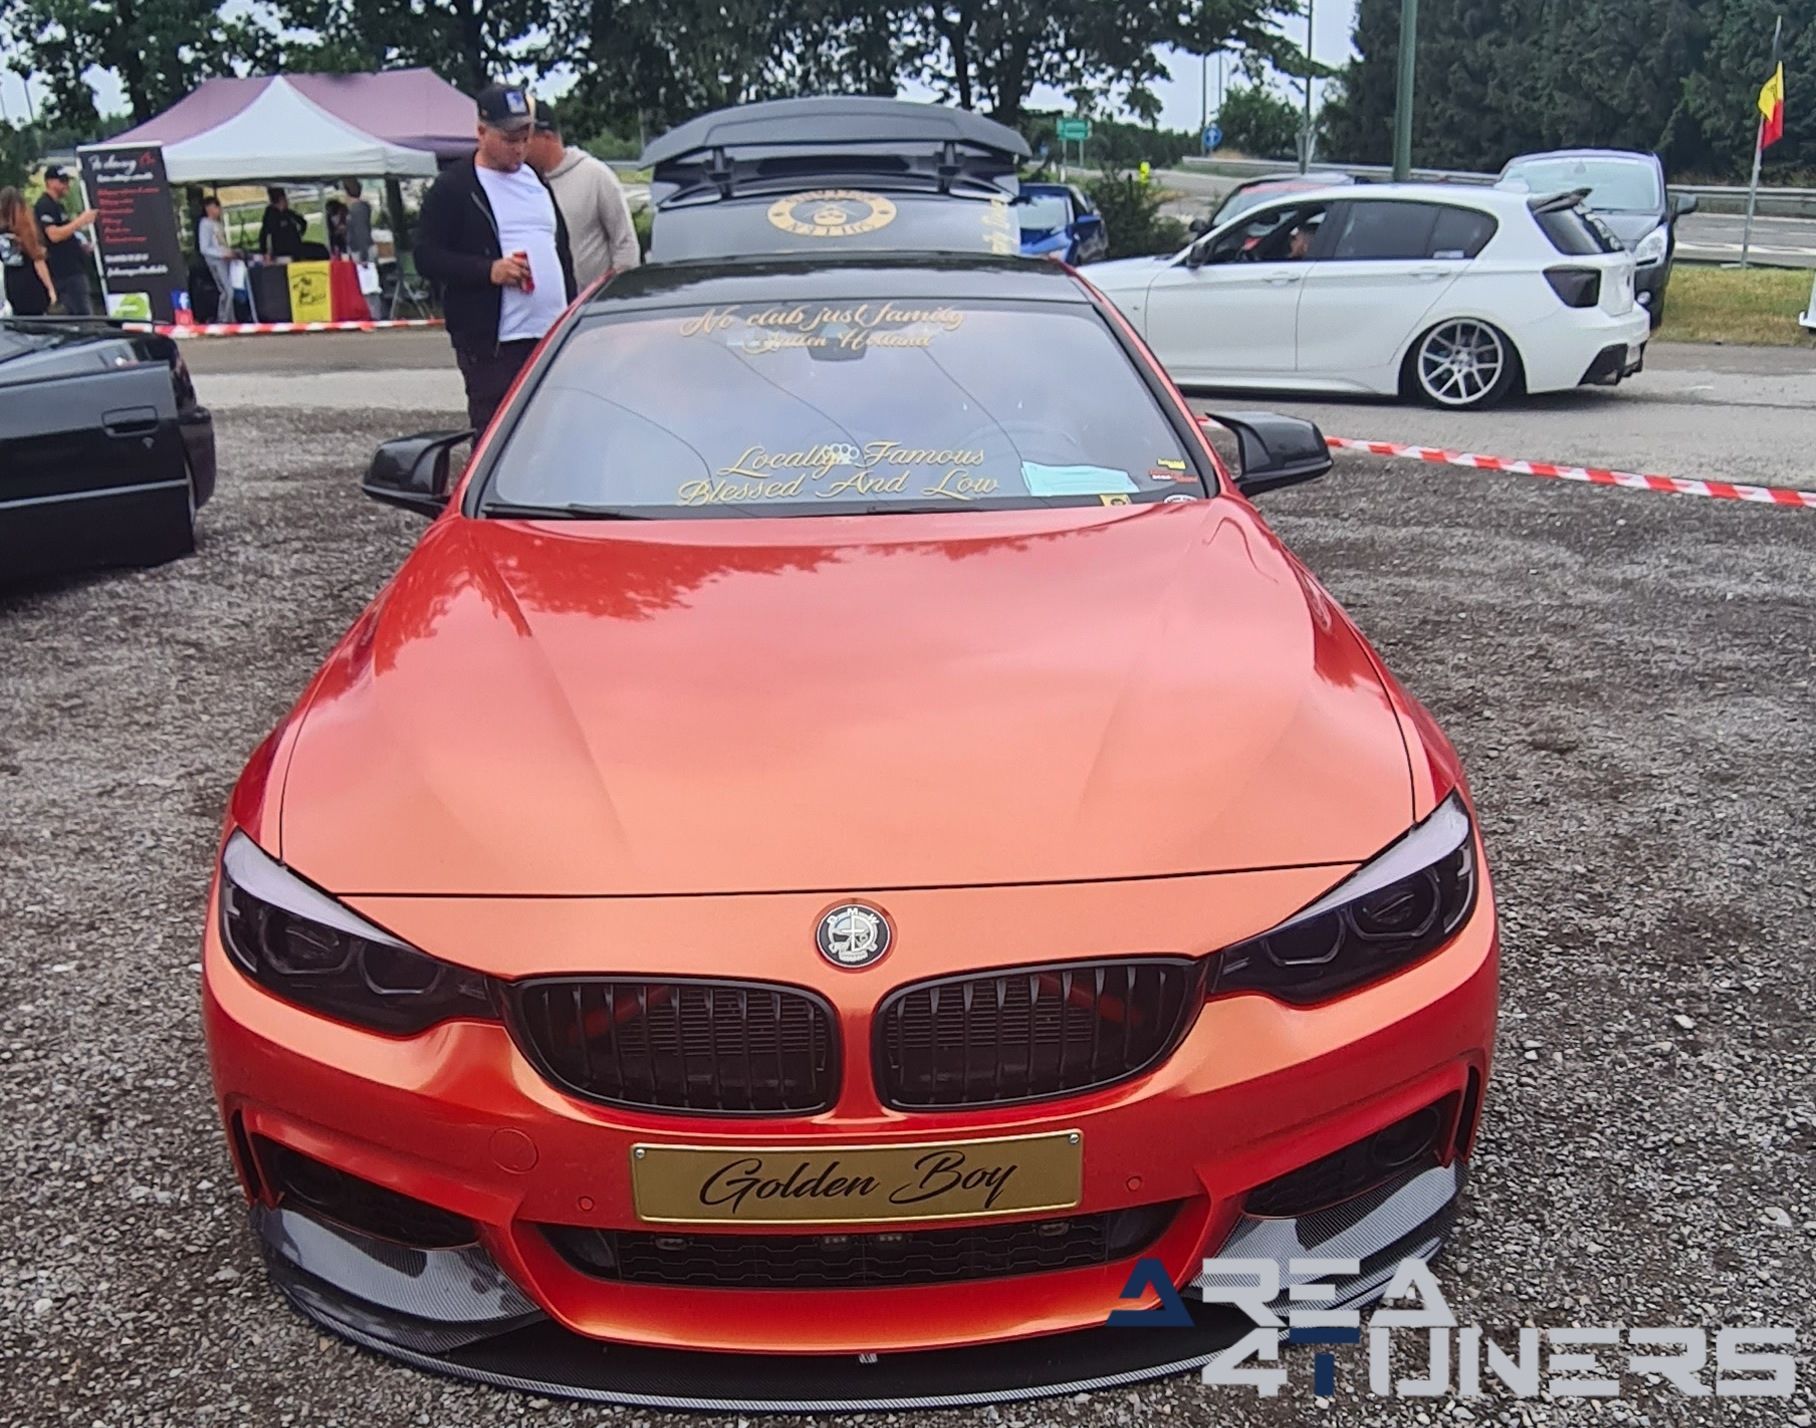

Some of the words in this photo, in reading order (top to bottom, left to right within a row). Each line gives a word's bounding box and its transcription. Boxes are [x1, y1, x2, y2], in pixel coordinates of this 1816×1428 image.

[680, 304, 741, 337] No
[745, 304, 812, 328] club
[799, 302, 869, 333] just
[866, 302, 964, 332] family
[717, 445, 838, 481] Locally
[854, 441, 984, 468] Famous
[679, 473, 806, 507] Blessed
[815, 470, 911, 498] And
[922, 468, 1000, 501] Low
[700, 1157, 880, 1214] Golden
[888, 1149, 1018, 1209] Boy
